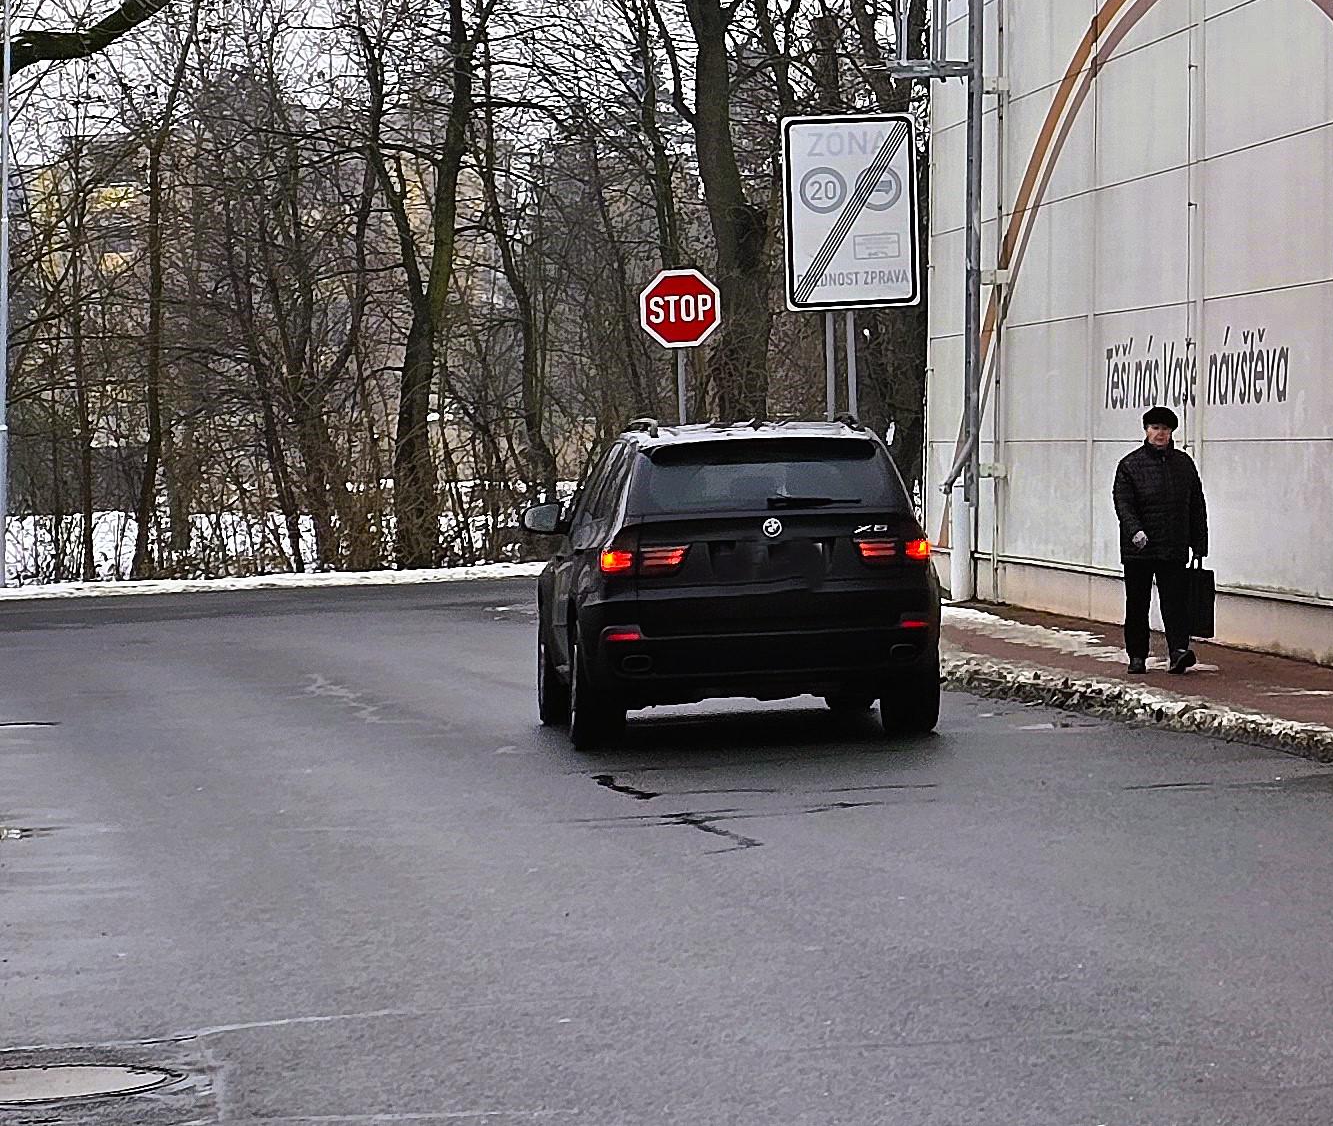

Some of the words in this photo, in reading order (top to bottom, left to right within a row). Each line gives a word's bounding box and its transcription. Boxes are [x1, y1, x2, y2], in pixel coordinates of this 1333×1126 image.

[809, 180, 837, 201] 20
[863, 269, 910, 286] ZPRAVA
[649, 294, 712, 324] STOP
[1104, 336, 1134, 410] Těší
[1132, 335, 1160, 409] nás
[1163, 337, 1198, 408] Vaše
[1206, 325, 1290, 406] návštěva
